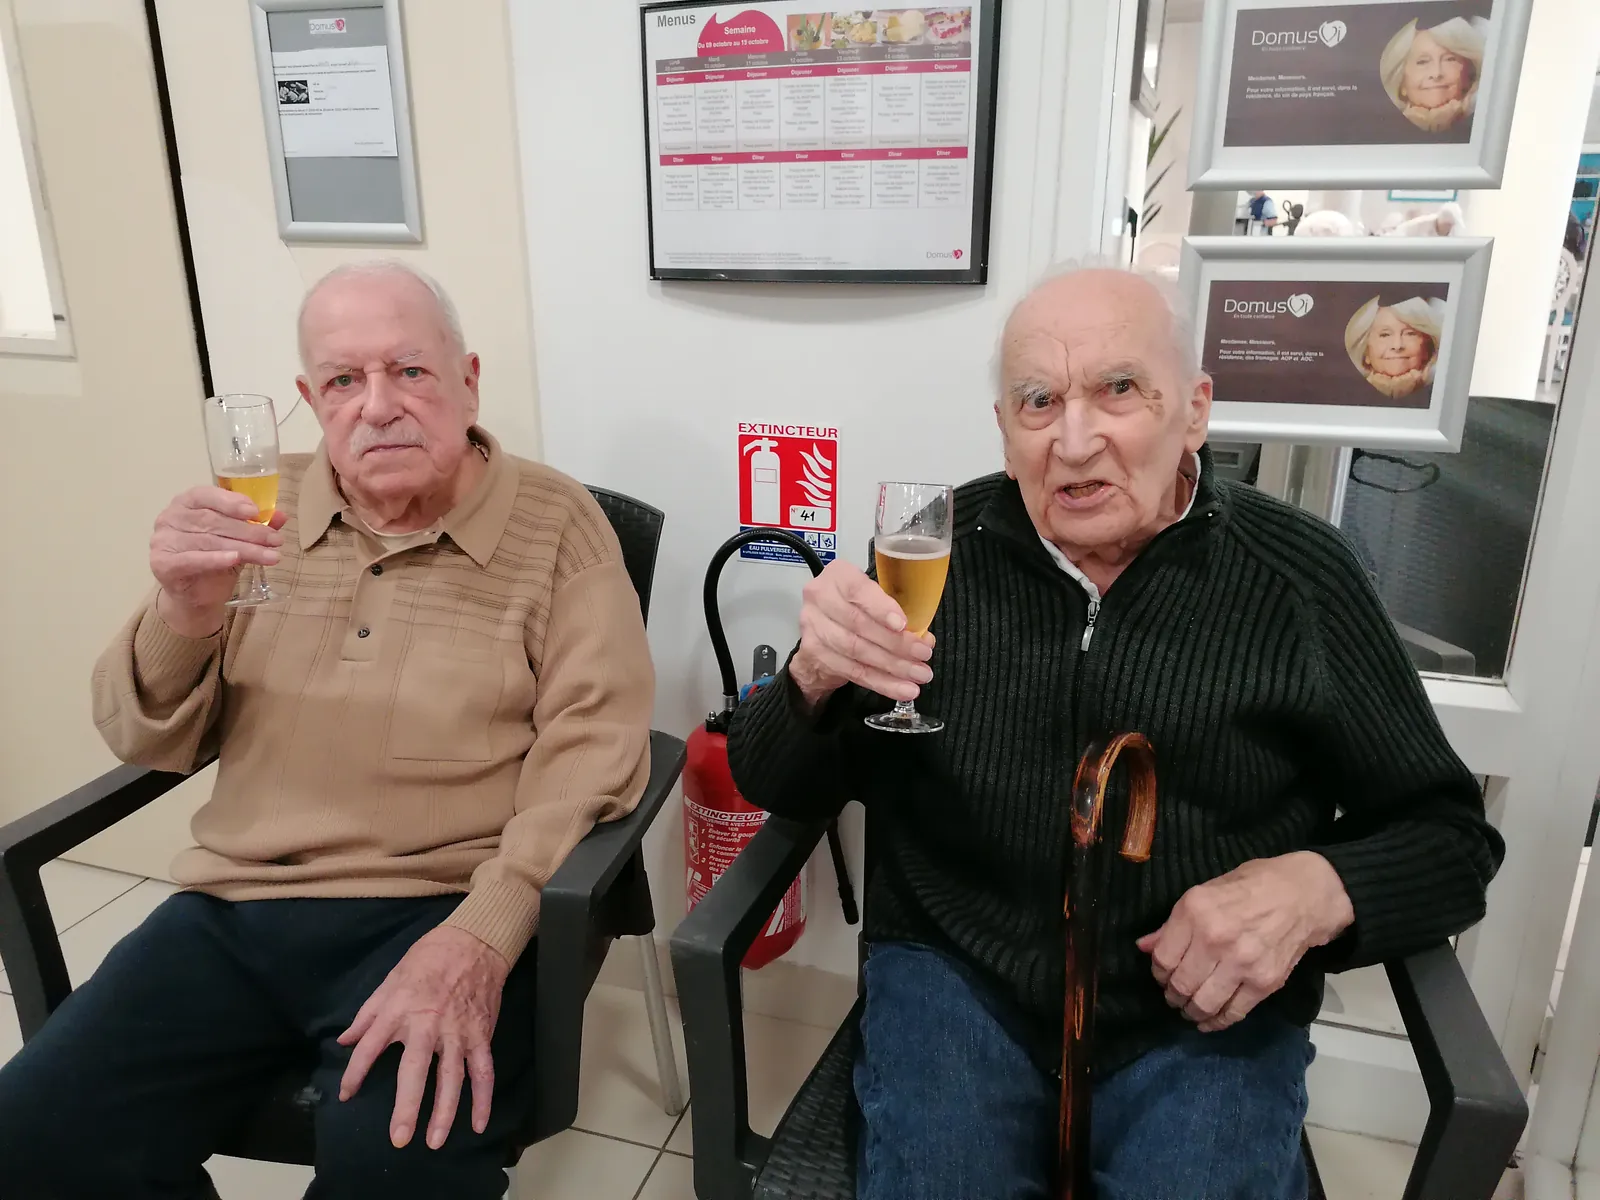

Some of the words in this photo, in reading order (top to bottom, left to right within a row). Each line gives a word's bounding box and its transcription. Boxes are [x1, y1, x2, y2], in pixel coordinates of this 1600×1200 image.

[657, 14, 696, 28] Menus
[724, 26, 756, 35] Semaine
[713, 40, 732, 48] octobre
[738, 422, 838, 438] EXTINCTEUR
[800, 510, 815, 521] 41
[690, 802, 764, 820] EXTINCTEUR
[708, 828, 730, 837] Enlever
[709, 842, 735, 852] Enfoncer
[709, 855, 731, 864] Presser
